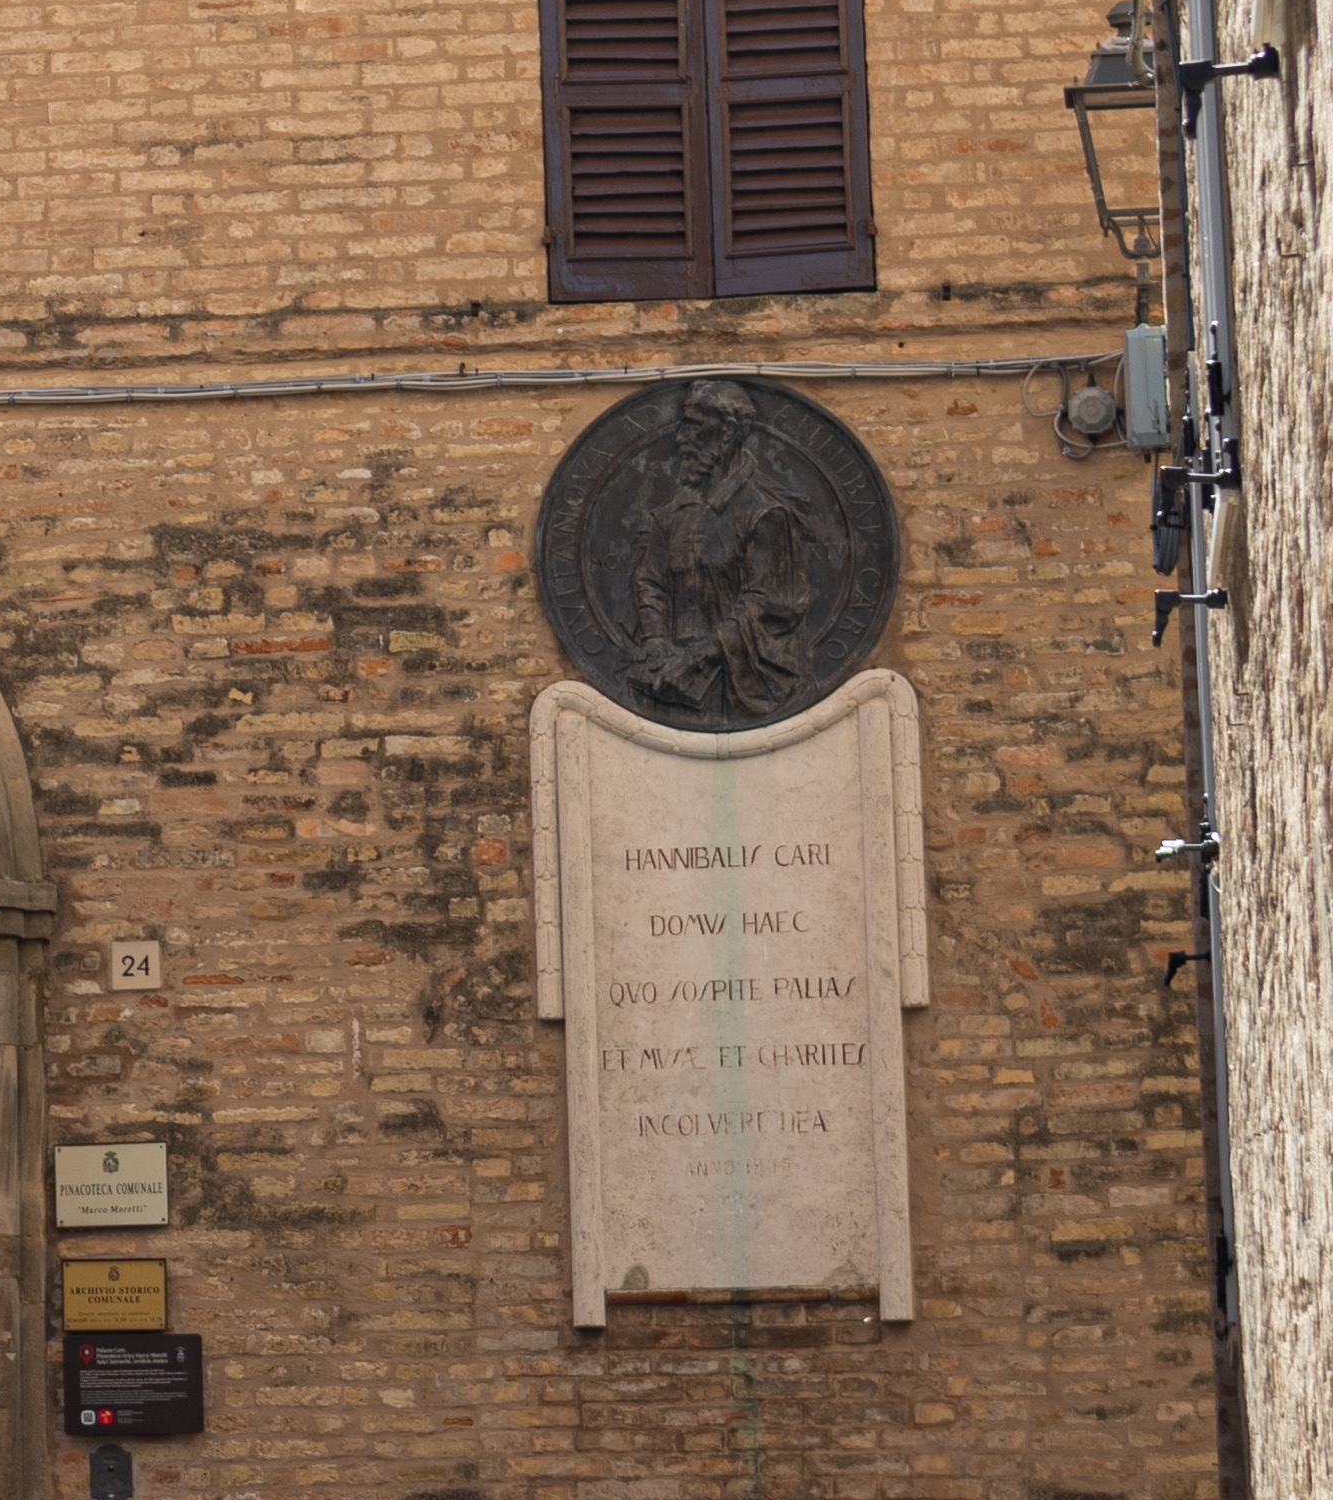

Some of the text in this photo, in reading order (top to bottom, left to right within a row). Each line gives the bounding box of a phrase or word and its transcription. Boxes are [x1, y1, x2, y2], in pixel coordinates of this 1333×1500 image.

[823, 567, 883, 660] CARO
[625, 843, 830, 871] HANNIBALIS CARI
[650, 910, 812, 937] DOMVS HAEC
[121, 955, 150, 977] 24
[609, 981, 658, 1008] QVO
[666, 978, 763, 1002] SOSPITE
[602, 1048, 630, 1072] ET
[719, 1045, 746, 1069] ET
[758, 1043, 867, 1067] CHARITES
[60, 1182, 163, 1197] PINACOTECA COMUNALE
[69, 1286, 160, 1295] ARCHIVIO STORICO
[88, 1296, 141, 1304] COMUNALE
